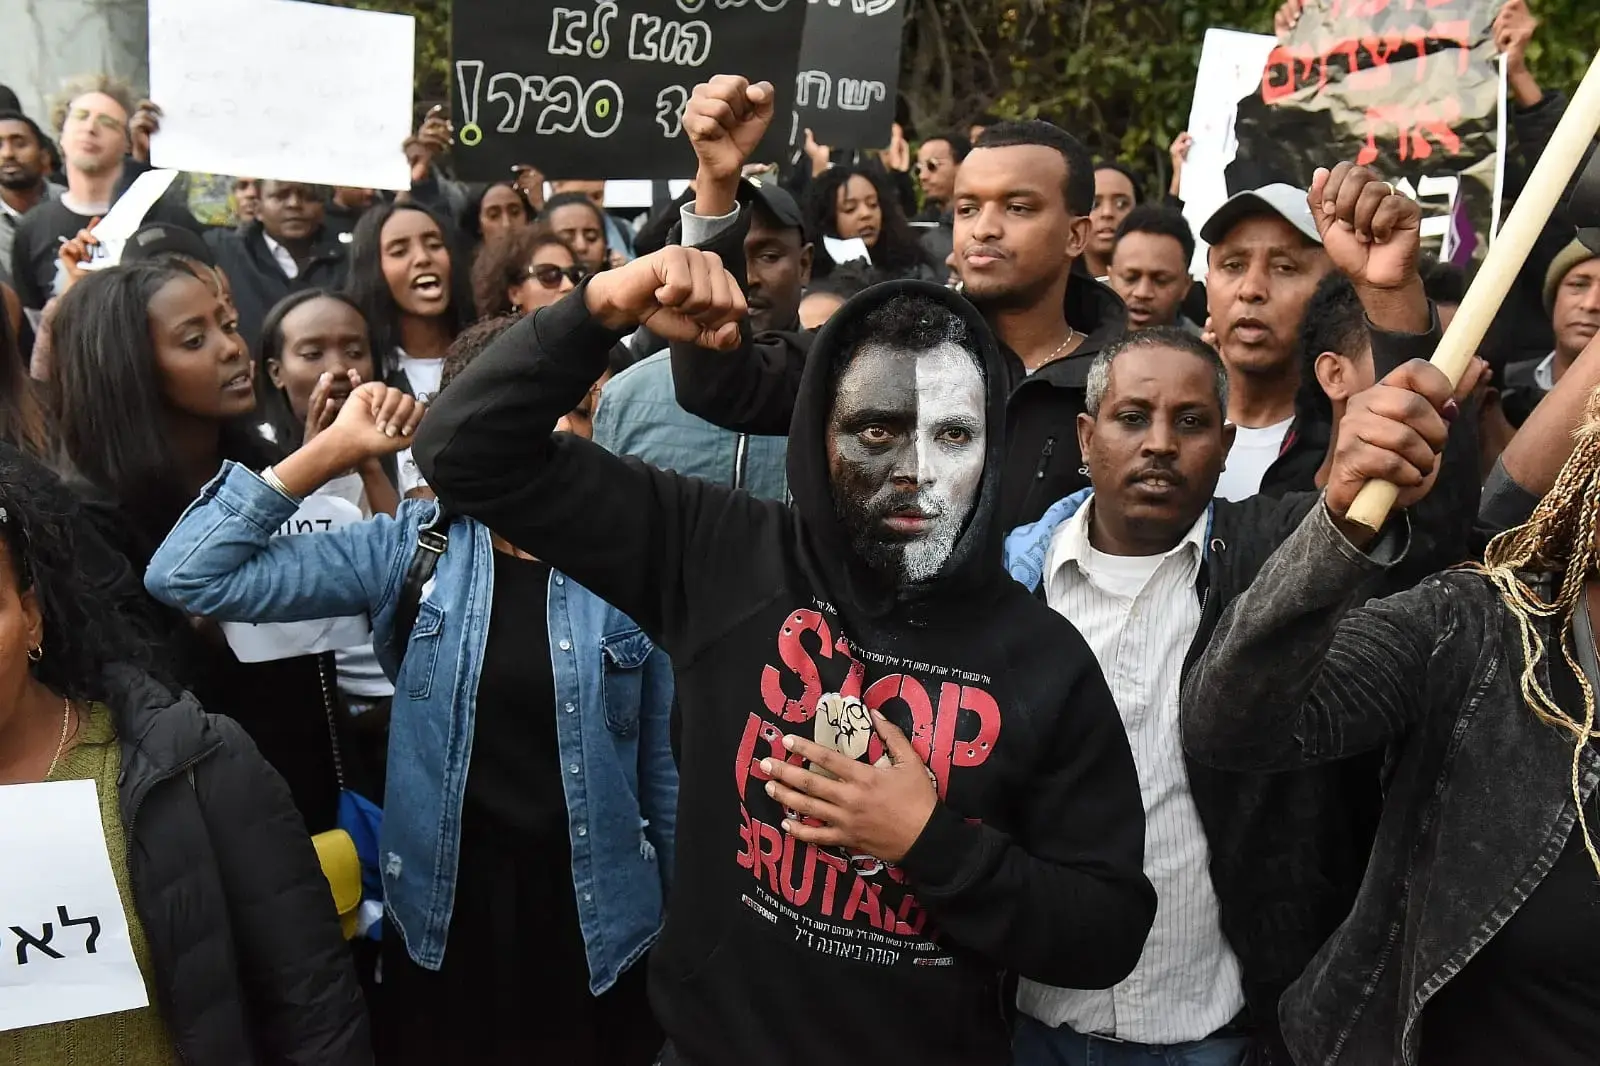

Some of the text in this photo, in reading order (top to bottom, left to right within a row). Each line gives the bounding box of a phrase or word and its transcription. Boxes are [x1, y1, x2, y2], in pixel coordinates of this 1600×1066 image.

[547, 3, 712, 67] הוא לא
[8, 904, 102, 966] לא
[865, 947, 900, 967] יהודה
